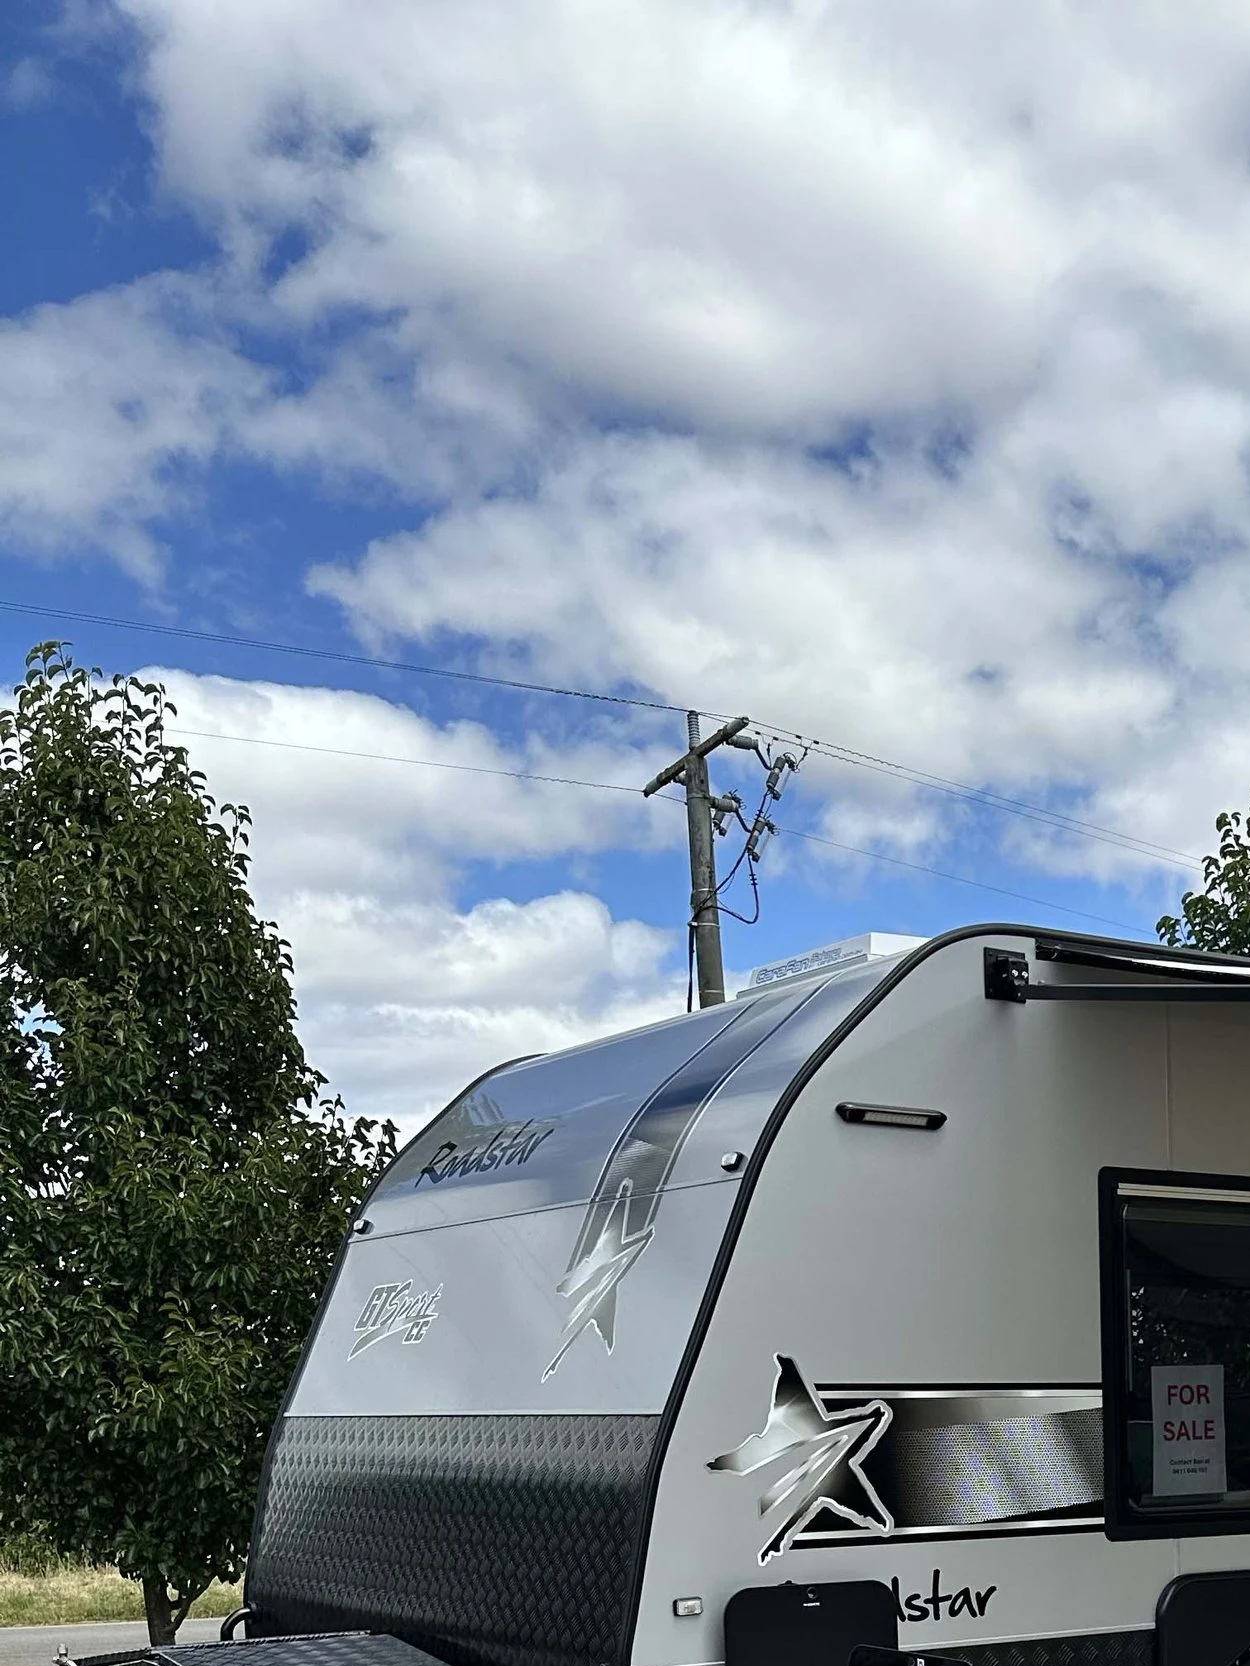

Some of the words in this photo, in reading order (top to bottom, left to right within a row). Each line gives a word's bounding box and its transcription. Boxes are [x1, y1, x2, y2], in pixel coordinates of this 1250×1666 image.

[414, 1117, 555, 1188] Roadstar
[1167, 1384, 1210, 1406] FOR
[1163, 1420, 1215, 1442] SALE
